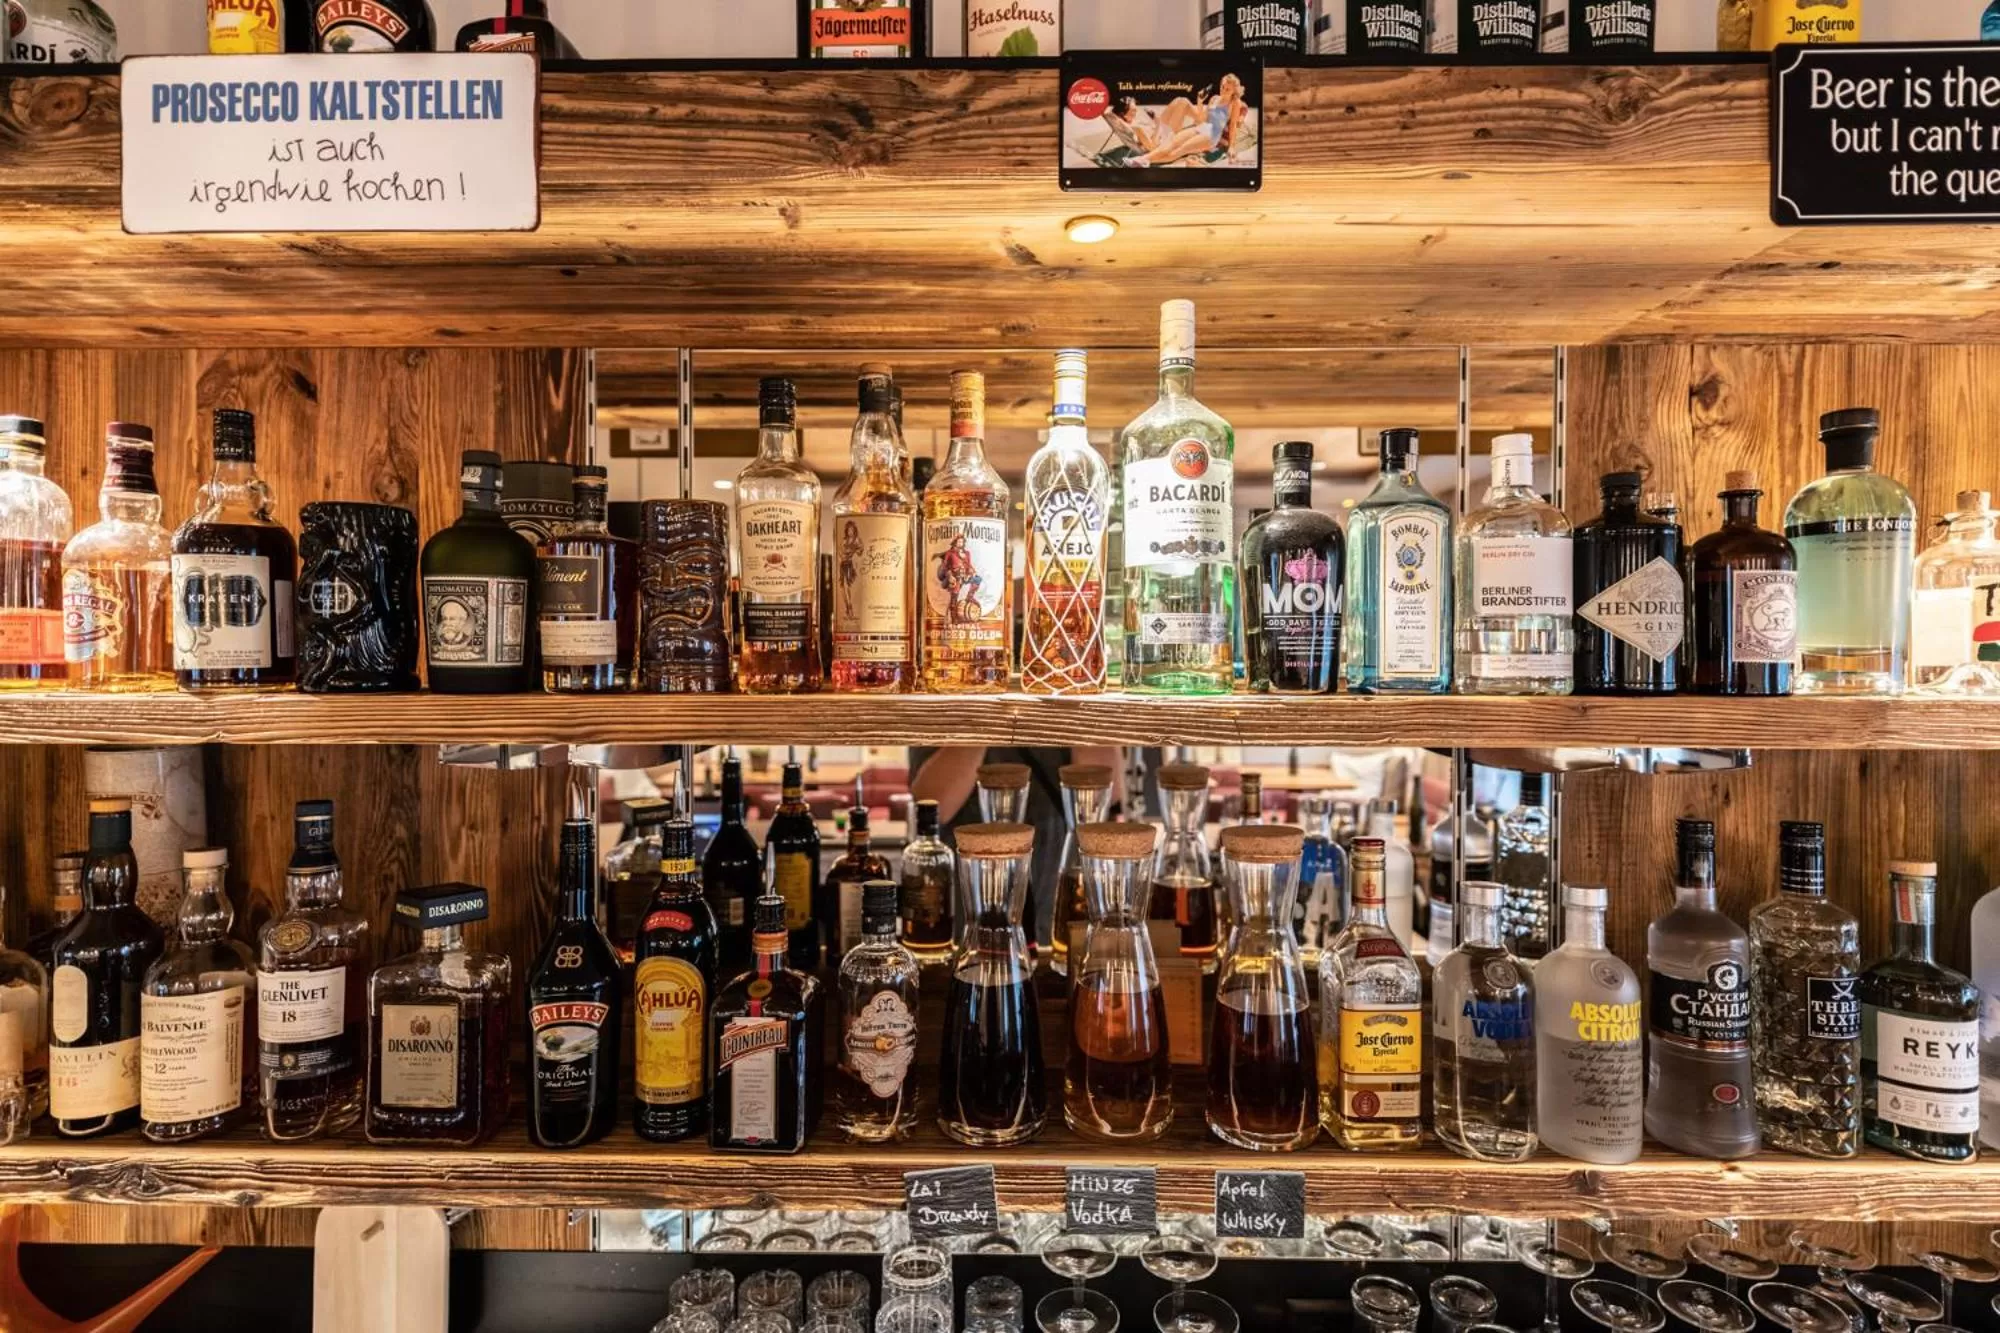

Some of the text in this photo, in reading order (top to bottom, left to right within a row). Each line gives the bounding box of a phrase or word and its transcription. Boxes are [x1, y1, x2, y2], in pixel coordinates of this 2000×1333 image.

[318, 3, 399, 33] BAILEYS
[968, 5, 1056, 31] Haselnuss
[1237, 3, 1300, 25] Distillerie
[1361, 4, 1422, 28] Distillerie
[1472, 2, 1537, 22] Distillerie
[1585, 2, 1651, 23] Distillerie
[1240, 19, 1297, 40] Willisau
[1364, 22, 1419, 44] Willisau
[1477, 18, 1533, 39] Willisau
[1590, 19, 1648, 39] Willisau
[1786, 16, 1855, 34] Jose Cuervo
[1135, 83, 1156, 91] about
[1810, 65, 2000, 109] Beer is the
[152, 79, 504, 123] PROSECCO KALTSTELLEN
[1831, 118, 1883, 153] but
[1891, 118, 1900, 152] I
[1909, 117, 1984, 152] can't
[268, 132, 385, 162] ist auch
[1889, 161, 1939, 196] the
[189, 168, 332, 213] irgendwie
[343, 168, 445, 202] kochen
[1149, 482, 1225, 502] BACARDÍ
[746, 520, 802, 537] OAKHEART
[1391, 523, 1430, 541] BOMBAY
[1831, 520, 1862, 533] THE
[1388, 577, 1431, 595] SAPPHIRE
[1482, 586, 1532, 596] BERLINER
[188, 594, 251, 603] KRAKEN
[1262, 583, 1344, 614] MOM
[1482, 597, 1567, 607] BRANDSTIFTER
[1644, 621, 1673, 631] GIN
[429, 898, 484, 918] DISARONNO
[261, 987, 329, 1001] GLENLIVET
[279, 981, 300, 991] THE
[636, 982, 701, 1014] KAHLÚA
[281, 1010, 297, 1022] 18
[533, 1005, 603, 1023] BAILEYS
[147, 1020, 207, 1032] BALVENIE
[388, 1039, 453, 1053] DISARONNO
[723, 1026, 783, 1060] COINTREAU
[1354, 1032, 1415, 1048] Jose Cuervo
[1373, 1047, 1398, 1056] Especial
[155, 1063, 167, 1074] 12
[537, 1068, 595, 1080] ORIGINAL
